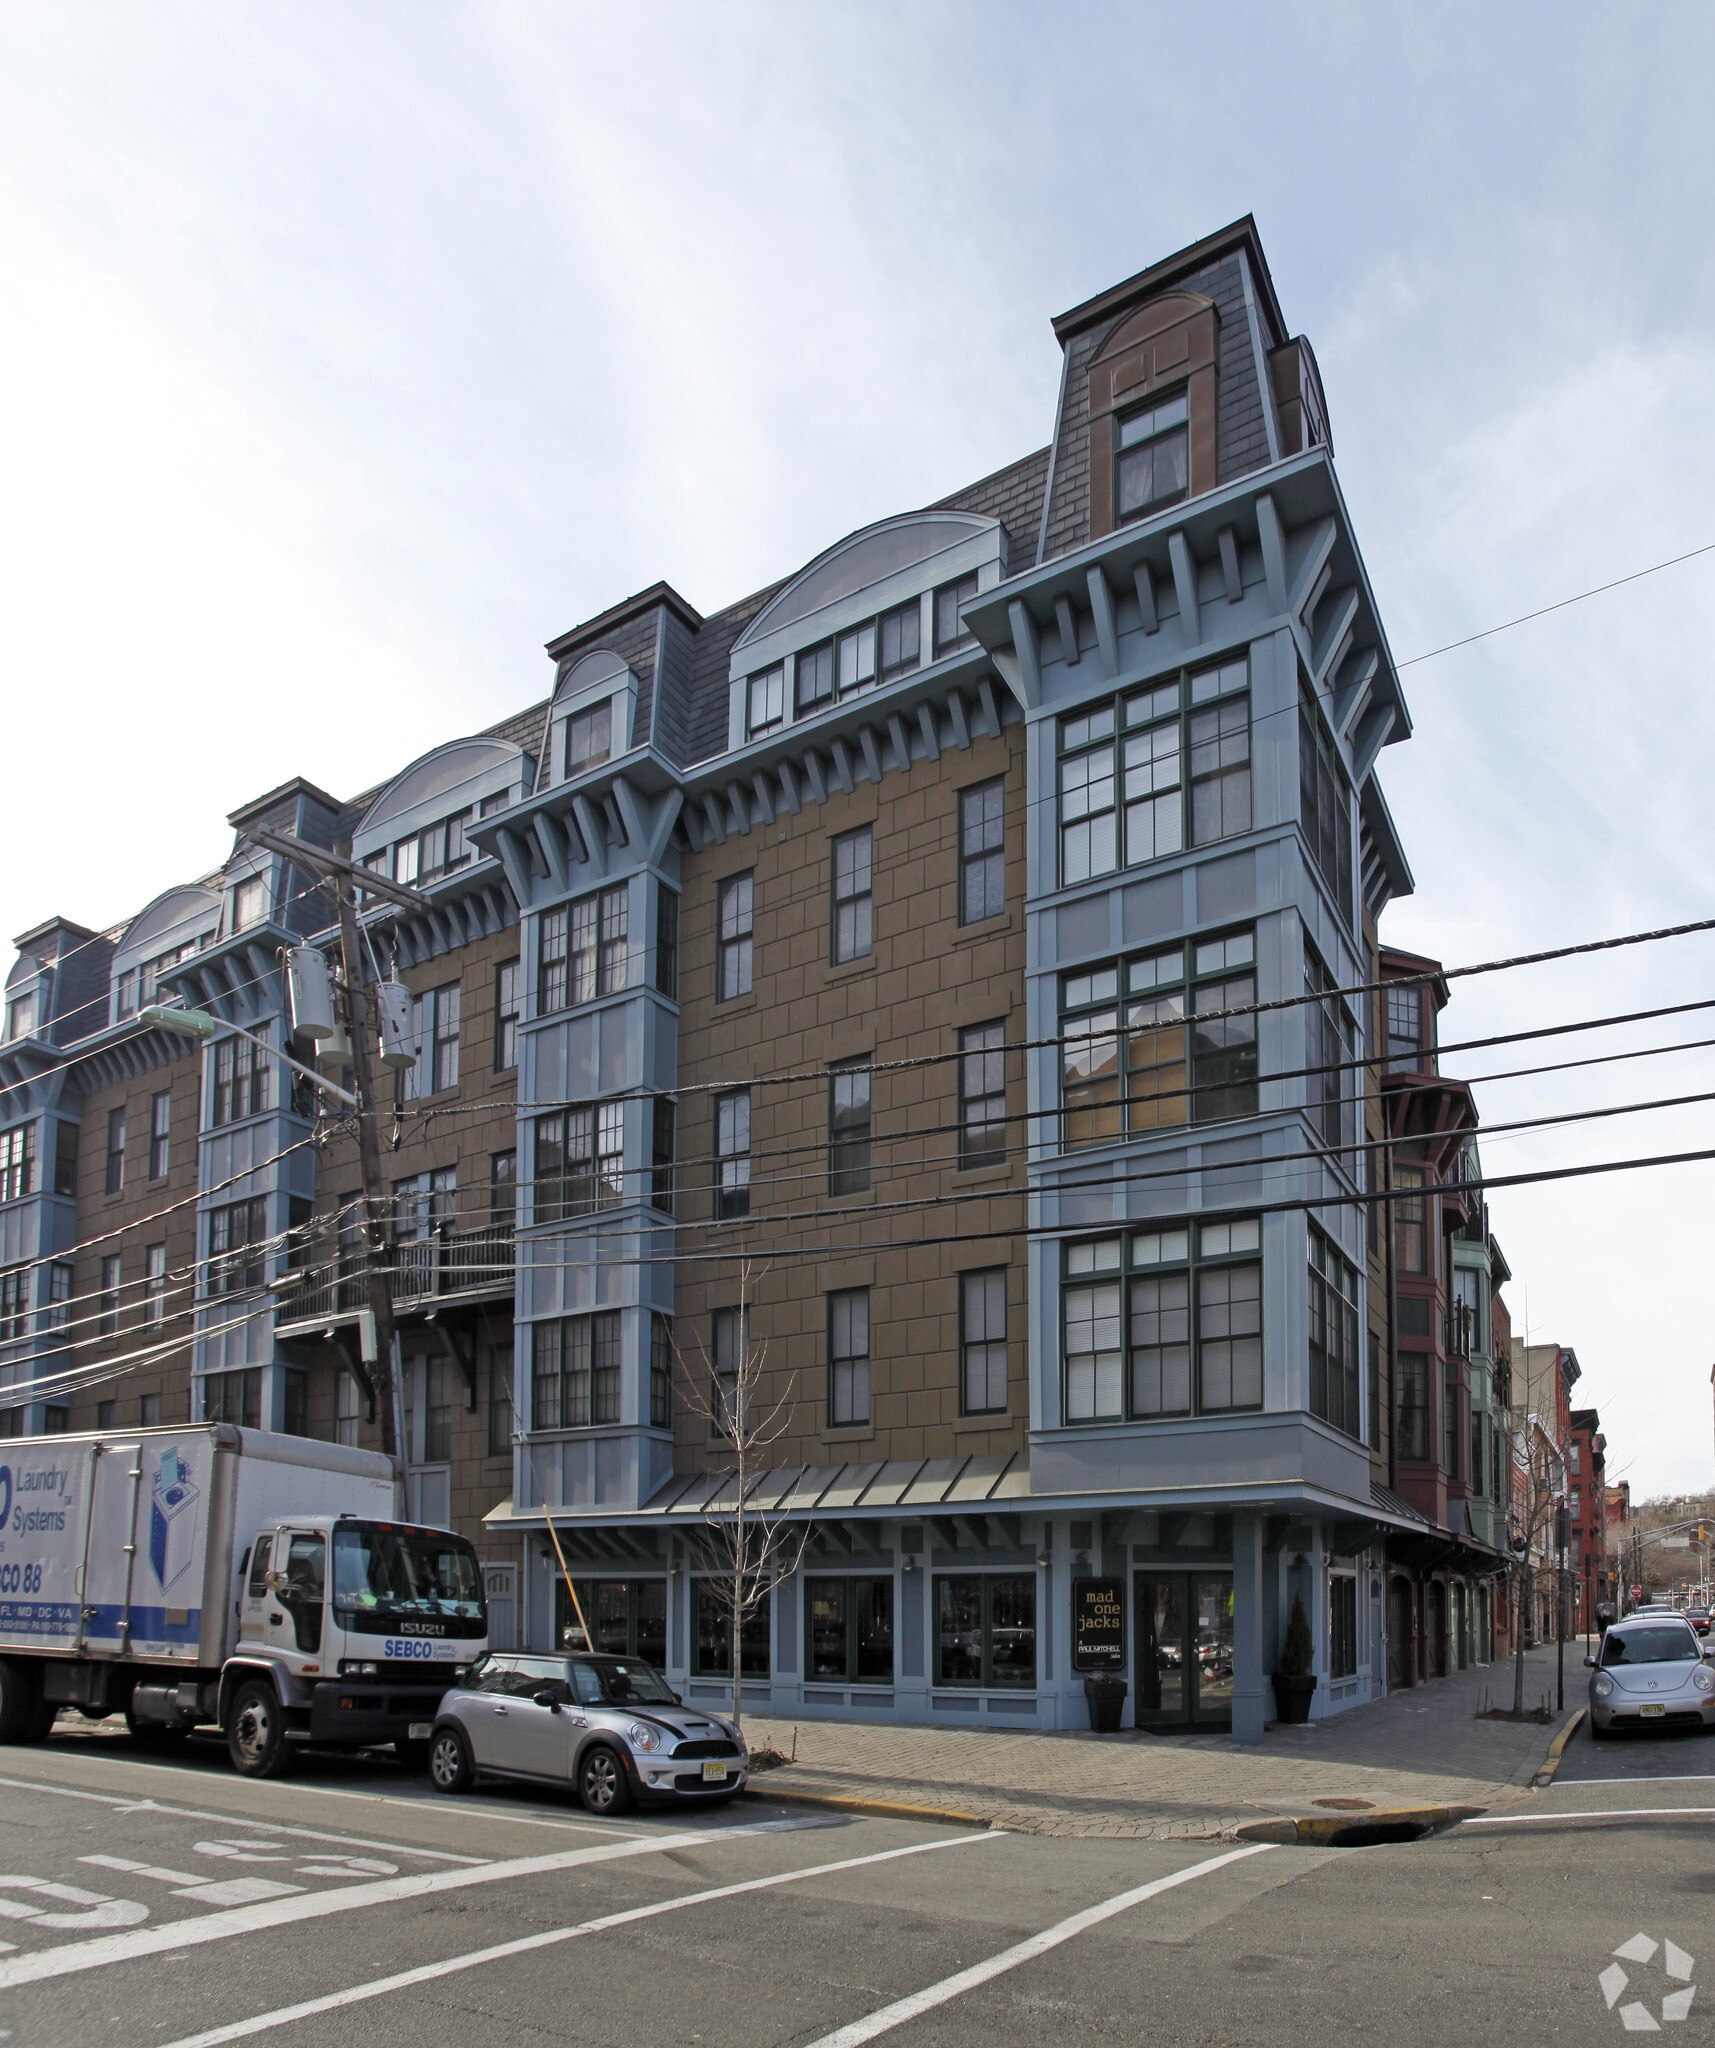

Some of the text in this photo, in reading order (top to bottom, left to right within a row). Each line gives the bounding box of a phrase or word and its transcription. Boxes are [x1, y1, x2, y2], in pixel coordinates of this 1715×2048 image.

[16, 1465, 68, 1497] Laundry
[13, 1505, 66, 1538] Systems
[23, 1563, 42, 1593] 88
[1086, 1590, 1114, 1603] mad
[17, 1606, 33, 1617] MD
[38, 1607, 52, 1618] DC
[58, 1607, 73, 1619] VA
[1094, 1604, 1120, 1614] one
[400, 1622, 445, 1635] ISUZU
[1079, 1614, 1120, 1631] jacks
[384, 1639, 432, 1659] SEBCO
[433, 1643, 455, 1652] Laundry
[1078, 1645, 1094, 1653] PAUL
[433, 1651, 456, 1660] Systems
